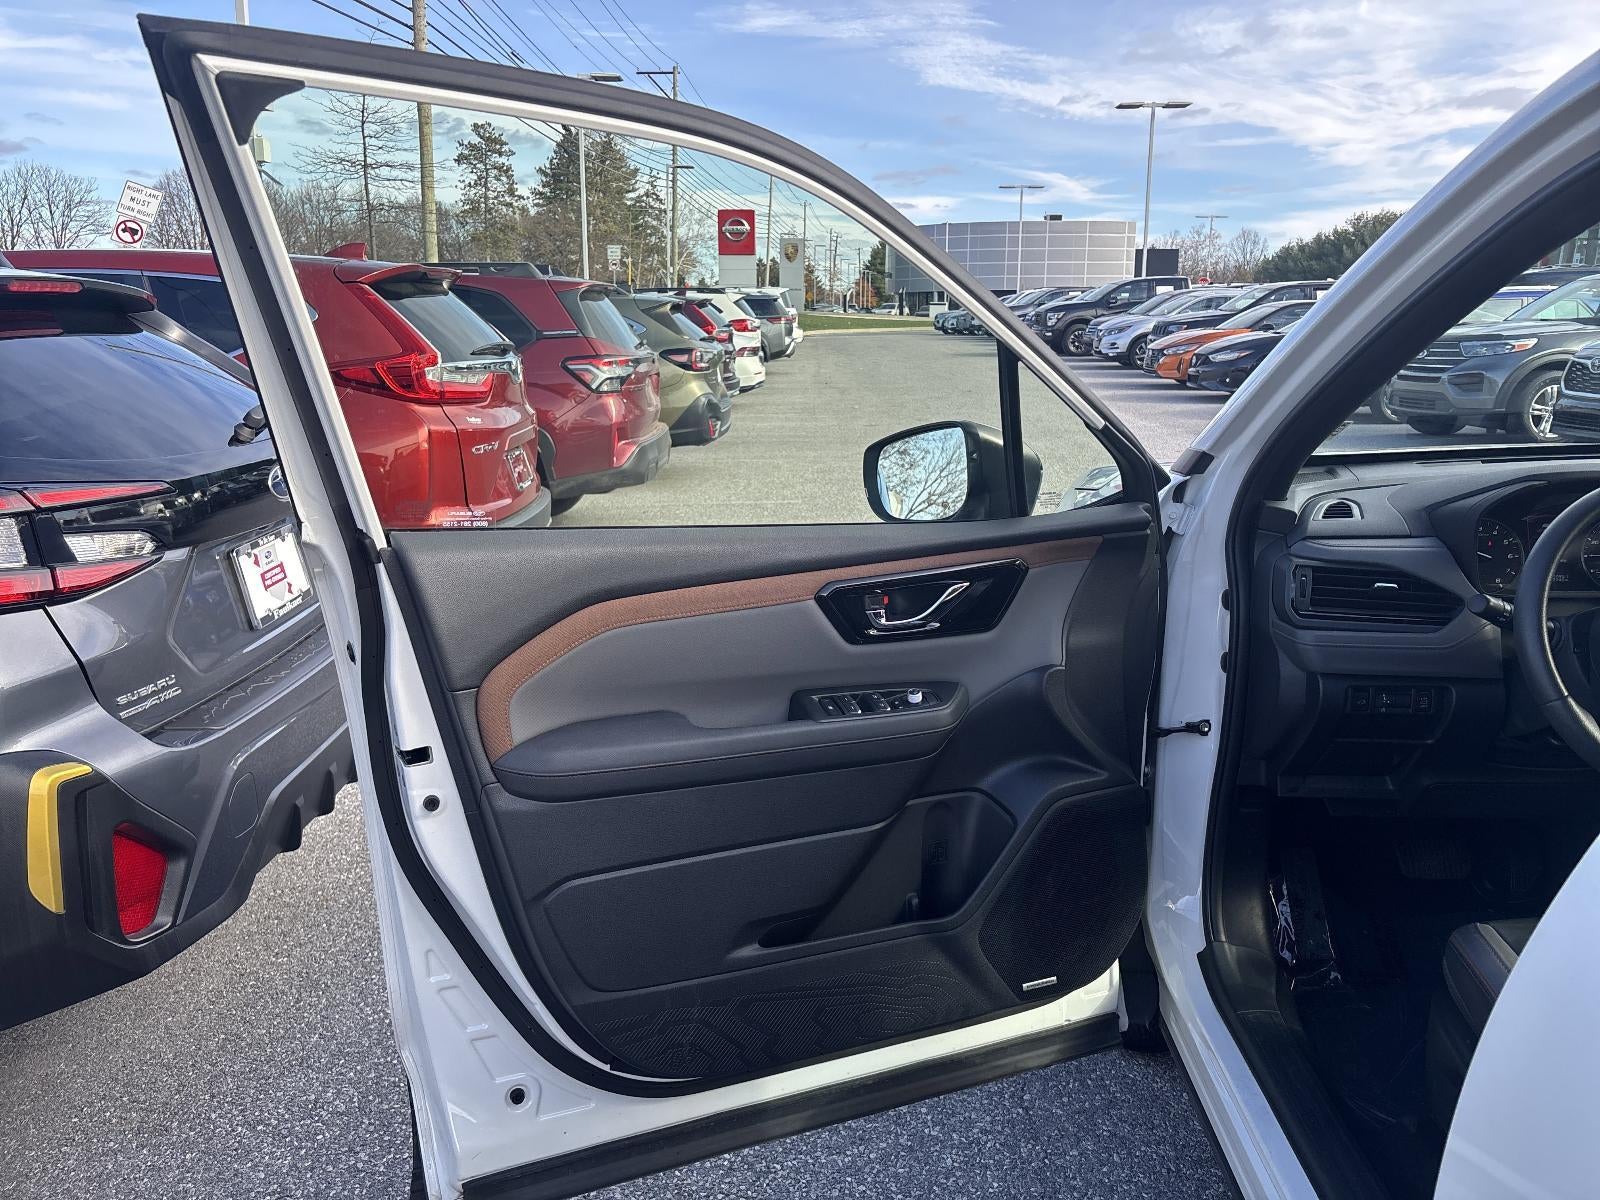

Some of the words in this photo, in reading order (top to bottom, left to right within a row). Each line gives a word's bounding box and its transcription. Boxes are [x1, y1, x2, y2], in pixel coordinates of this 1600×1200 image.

[127, 185, 144, 195] RIGHT
[145, 191, 160, 200] LANE
[129, 196, 151, 208] MUST
[120, 203, 135, 213] TURN
[137, 208, 154, 219] RIGHT
[116, 674, 176, 705] SUBARU
